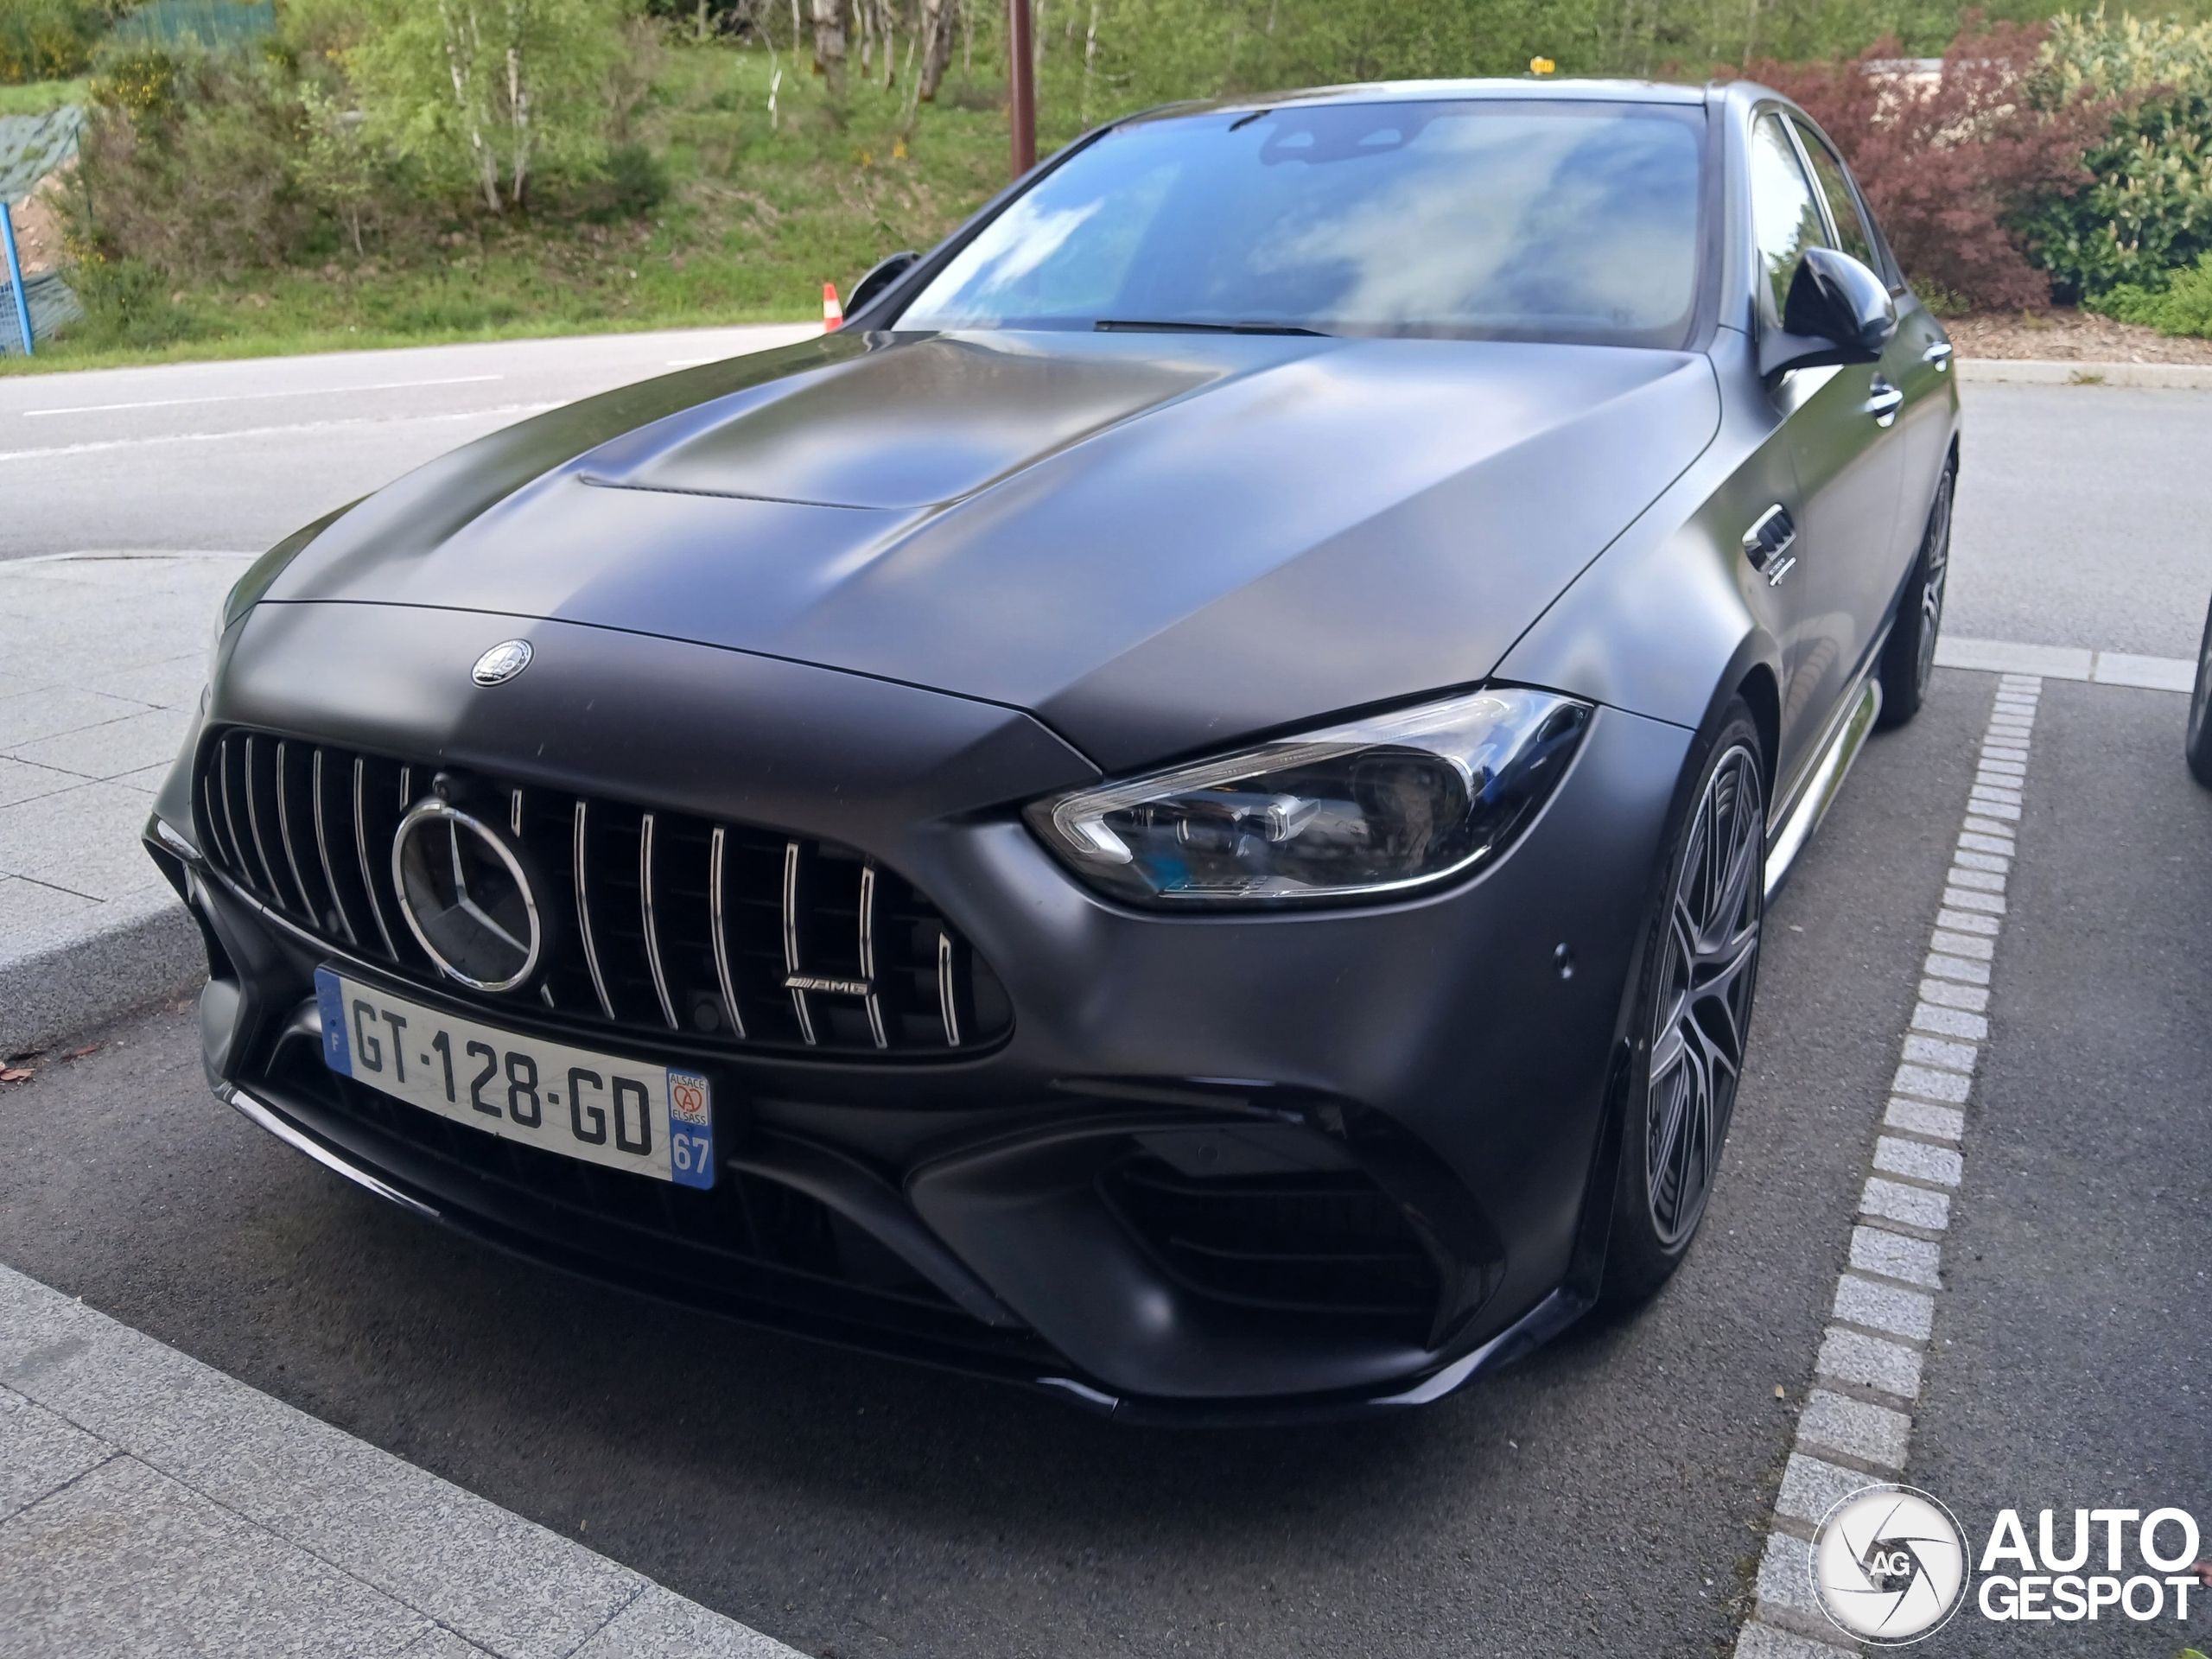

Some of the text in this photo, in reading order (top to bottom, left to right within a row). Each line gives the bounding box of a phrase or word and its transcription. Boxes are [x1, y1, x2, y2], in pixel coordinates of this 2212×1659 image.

[332, 1033, 339, 1052] F
[353, 999, 652, 1156] GT-128-GD
[671, 1074, 704, 1090] ALSACE
[672, 1109, 706, 1125] ELSASS
[673, 1133, 709, 1173] 67
